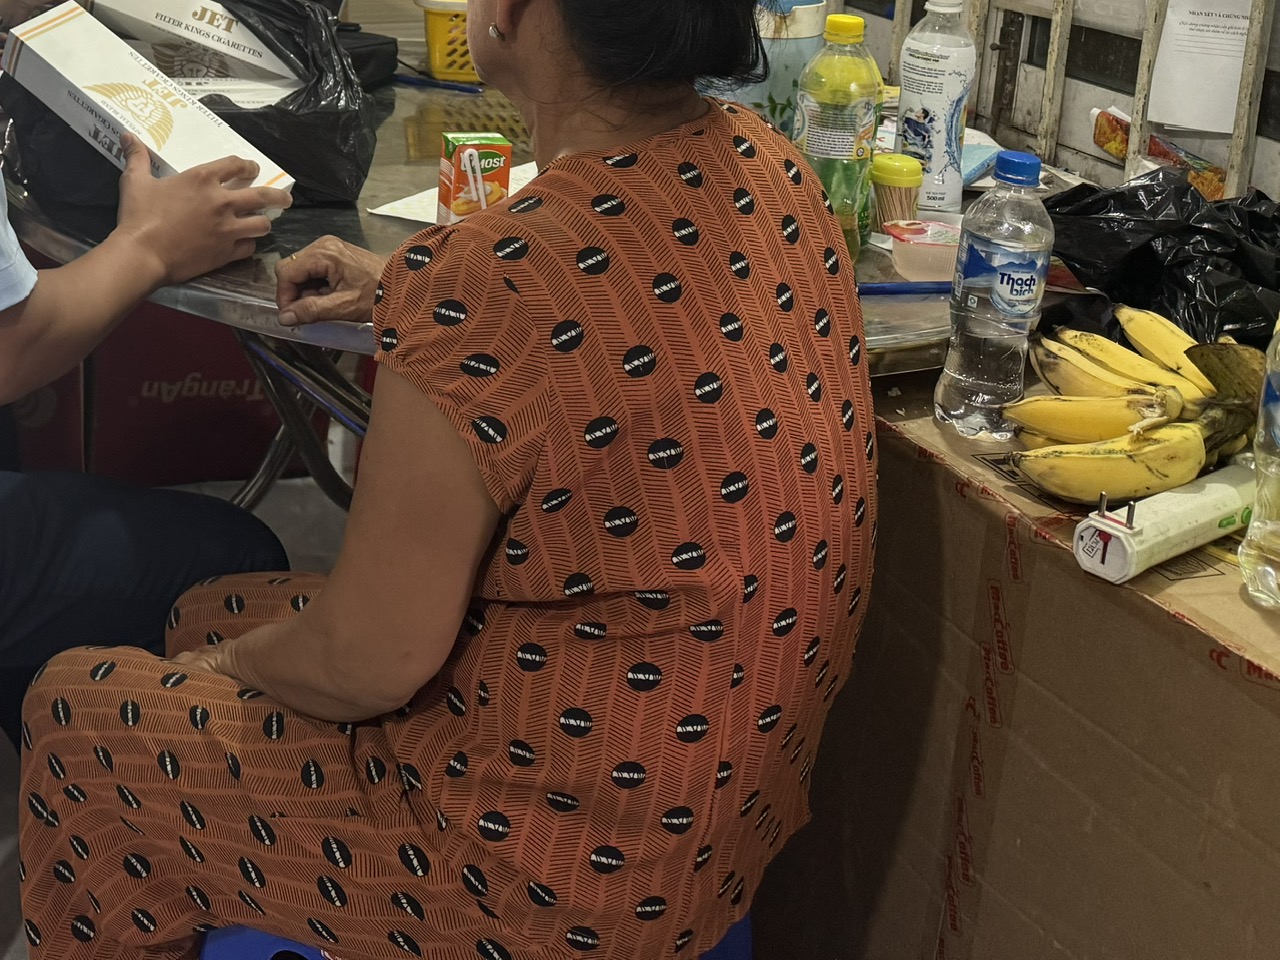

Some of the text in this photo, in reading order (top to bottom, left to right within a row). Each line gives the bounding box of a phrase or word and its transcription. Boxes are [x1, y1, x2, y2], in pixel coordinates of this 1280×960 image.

[155, 12, 263, 59] FILTER KINGS CIGARETTES
[192, 6, 240, 33] JET
[129, 51, 172, 85] CIGARETTES
[67, 90, 111, 130] CIGARETTES
[143, 77, 189, 110] JET
